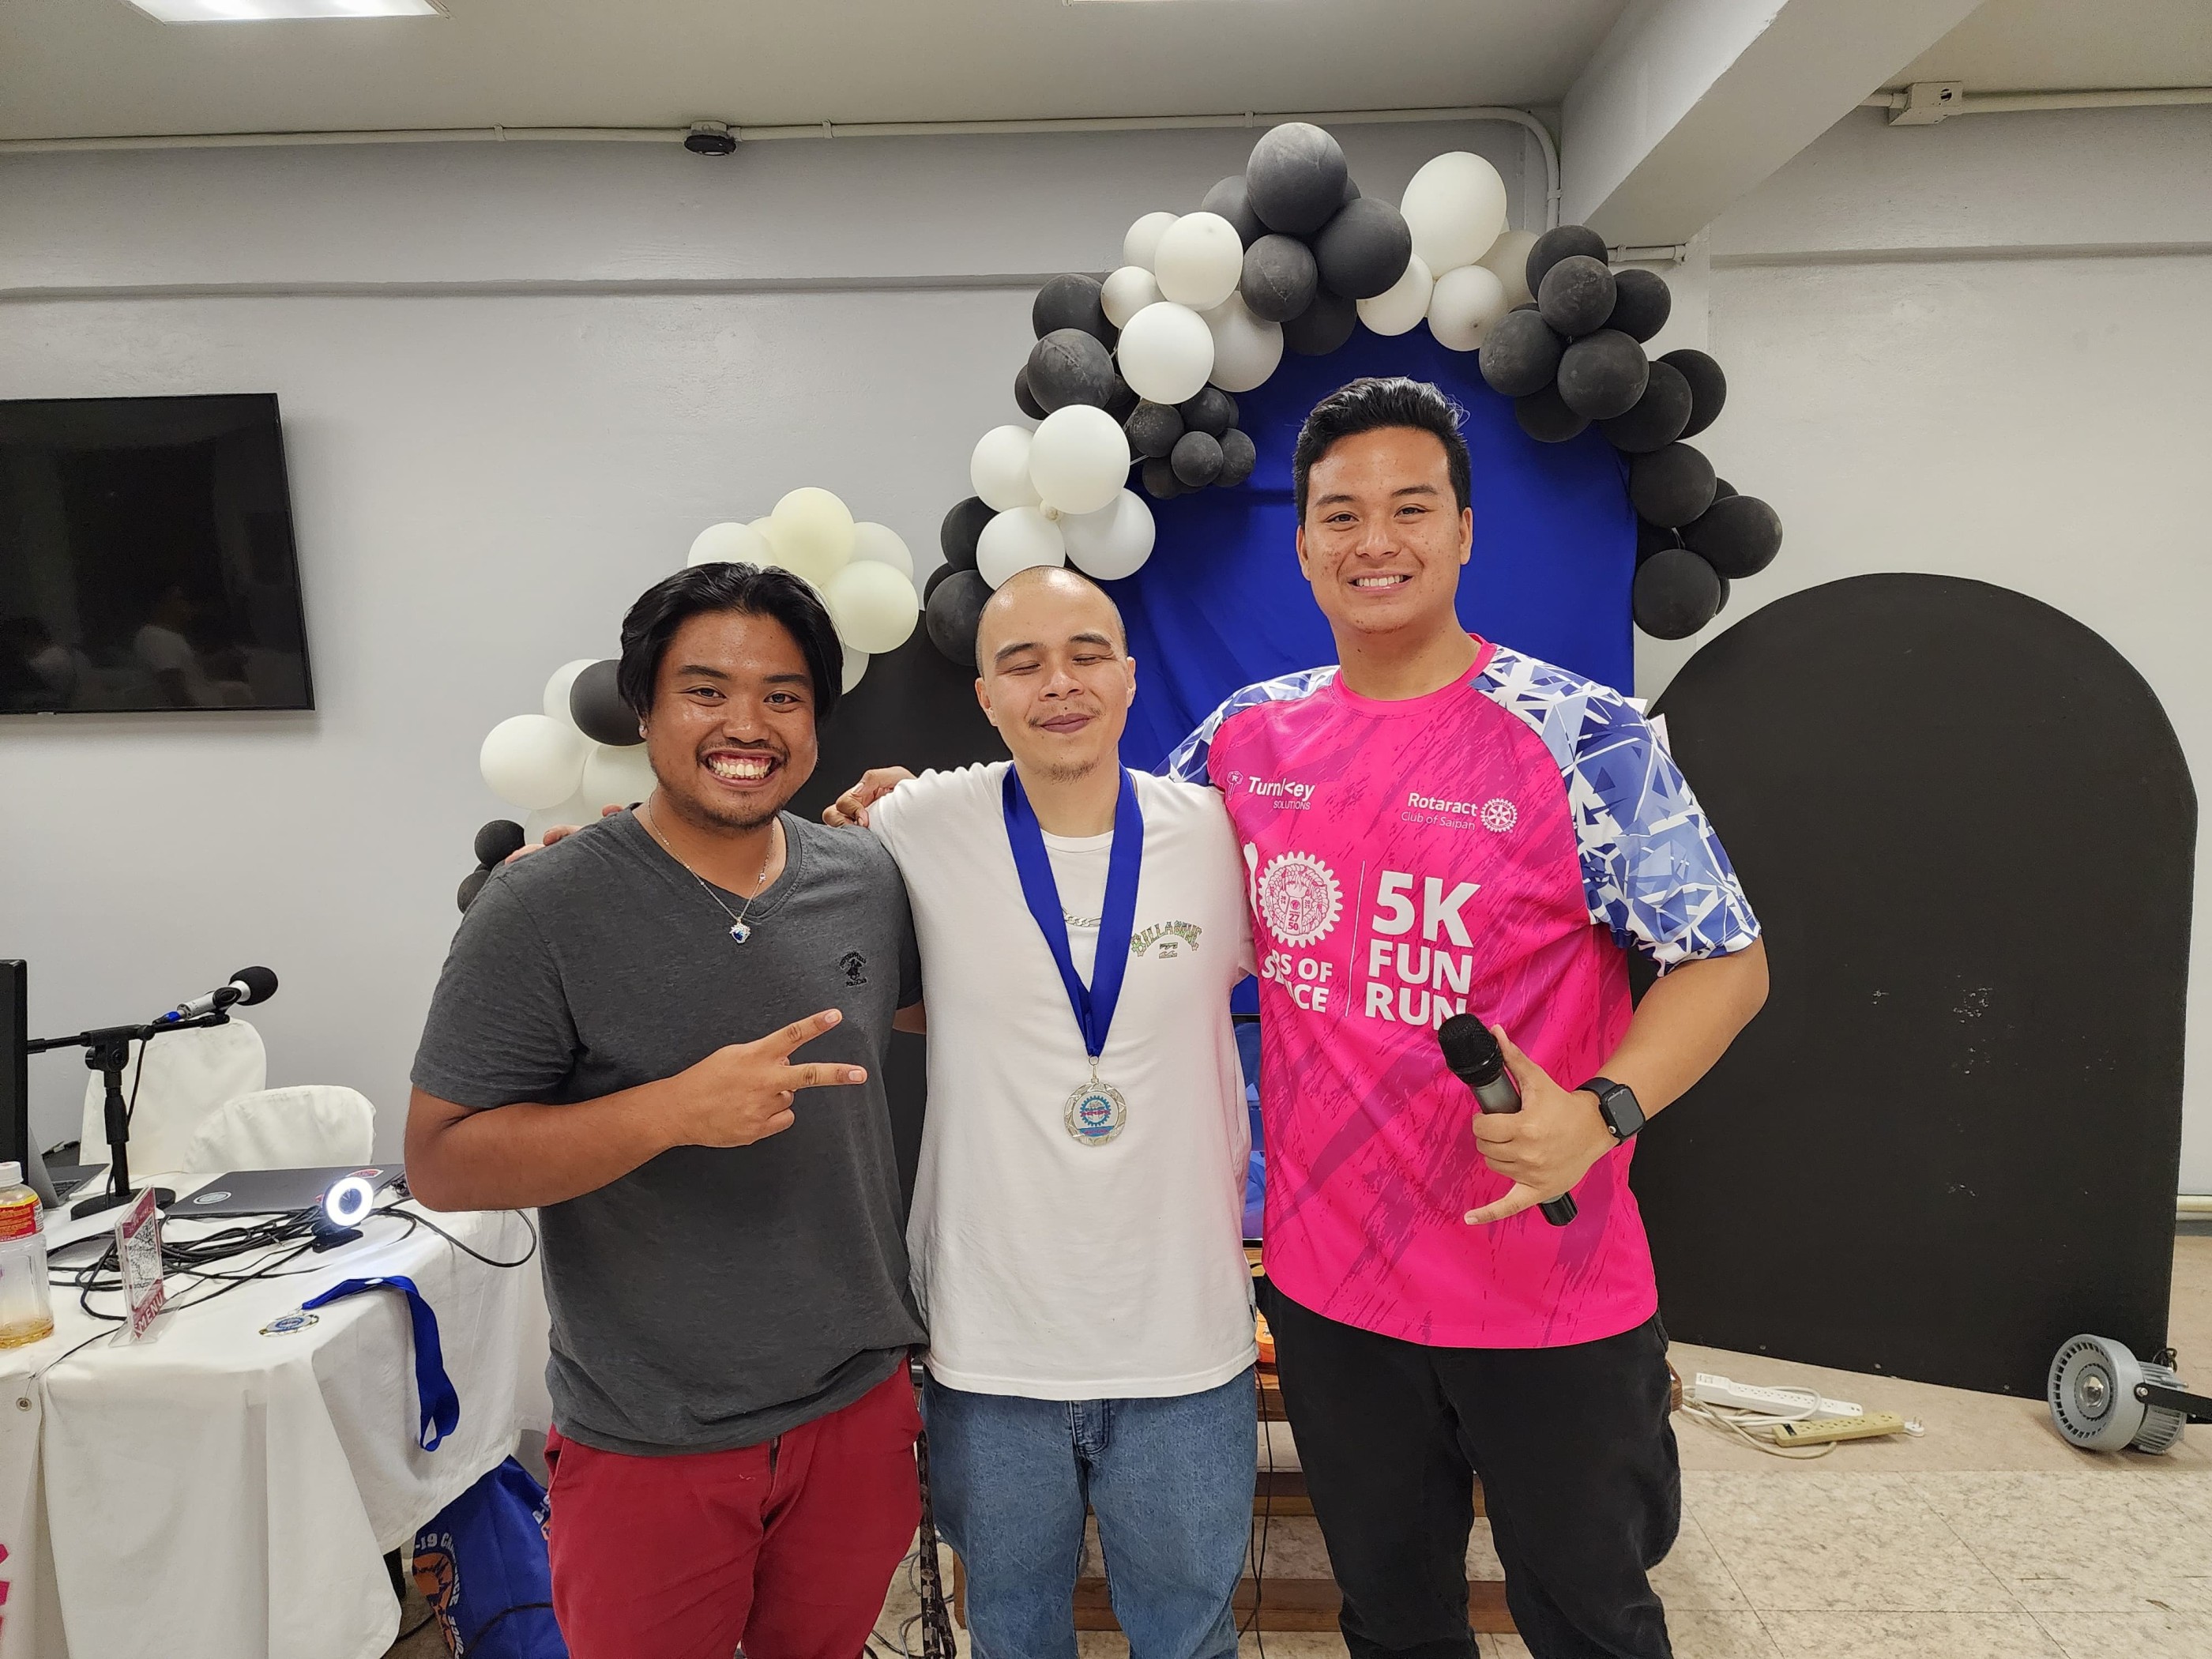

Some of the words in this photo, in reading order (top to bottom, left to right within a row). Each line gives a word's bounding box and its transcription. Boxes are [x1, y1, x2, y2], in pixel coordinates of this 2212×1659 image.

[1273, 800, 1311, 810] SOLUTIONS
[1408, 792, 1478, 817] Rotaract
[1401, 811, 1424, 823] Club
[1426, 814, 1439, 825] of
[1439, 816, 1476, 830] Saipan
[1288, 913, 1300, 922] 27
[1372, 870, 1481, 948] 5K
[1288, 922, 1299, 931] 50
[1298, 957, 1333, 983] OF
[1368, 939, 1473, 995] FUN
[1365, 981, 1468, 1031] RUN
[137, 1291, 163, 1334] MENU
